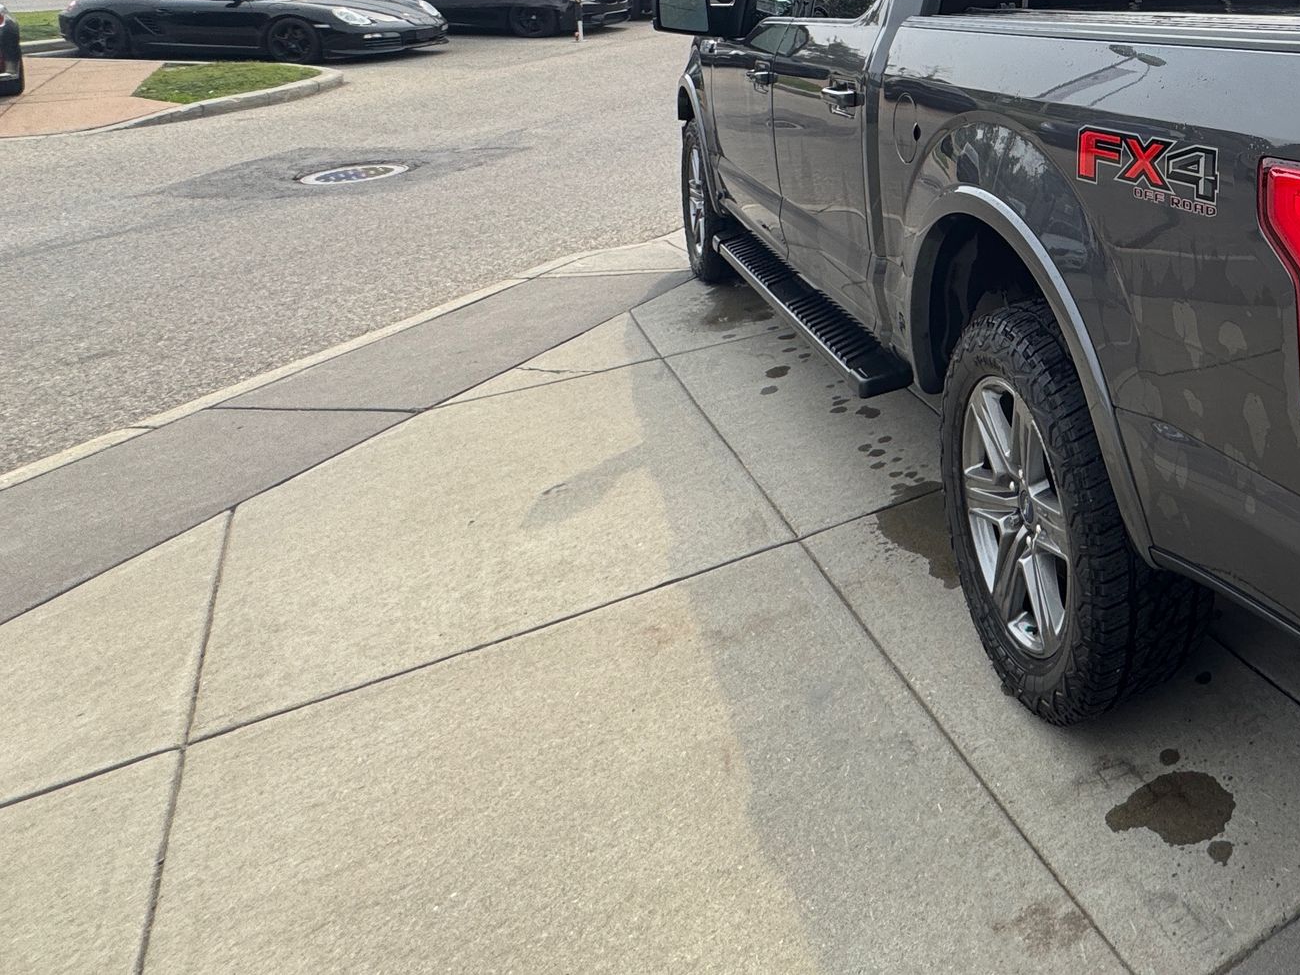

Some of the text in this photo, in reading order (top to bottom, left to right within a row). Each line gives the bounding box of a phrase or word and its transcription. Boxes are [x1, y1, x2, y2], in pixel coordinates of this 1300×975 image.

[1076, 124, 1220, 206] FX4
[1133, 186, 1217, 217] OFF ROAD
